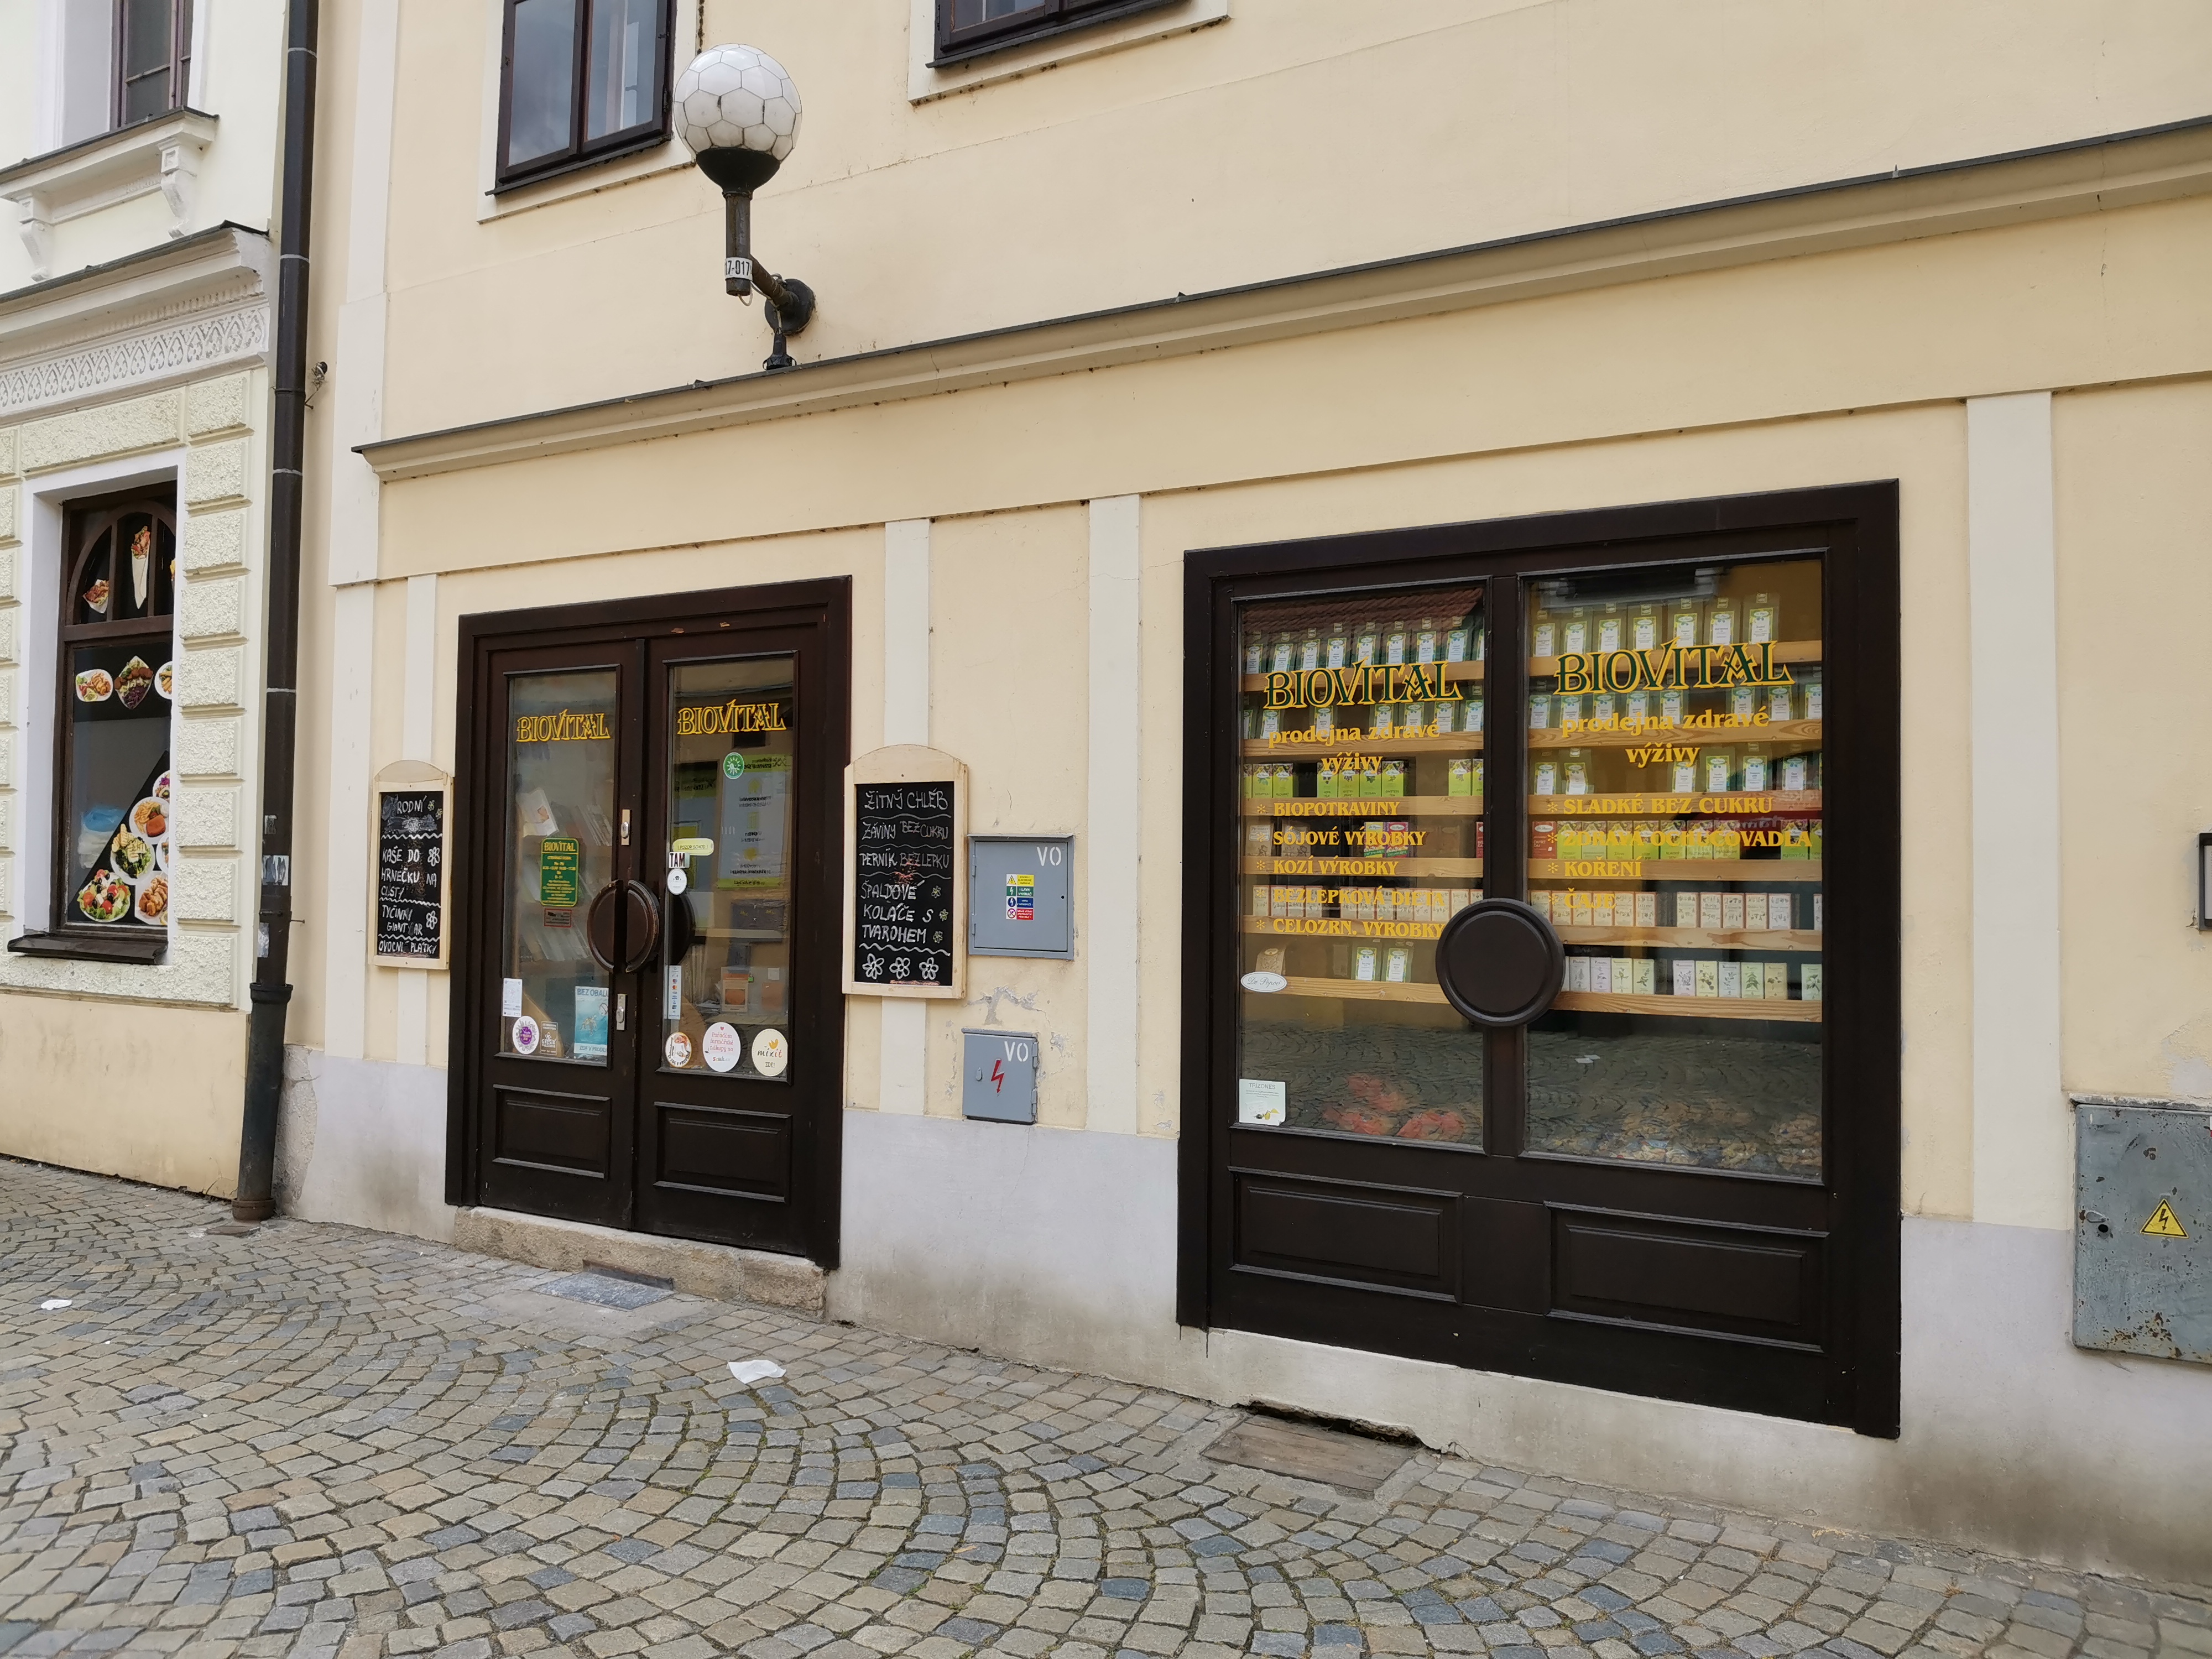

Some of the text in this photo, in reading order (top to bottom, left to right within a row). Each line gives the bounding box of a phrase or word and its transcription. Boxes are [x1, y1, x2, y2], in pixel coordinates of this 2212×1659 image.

[1553, 637, 1796, 695] BIOVITAL
[1264, 656, 1463, 709] BIOVITAL
[517, 709, 611, 742] BIOVITAL
[677, 699, 786, 734] BIOVITAL
[1562, 706, 1770, 738] prodejna zdravé
[1269, 719, 1440, 748] prodejna zdravé
[1321, 752, 1383, 774] výživy
[1625, 742, 1700, 768] výživy
[864, 787, 948, 810] ŽITNÝ CHLÉB
[1274, 801, 1400, 817] BIOPOTRAVINY
[1563, 793, 1773, 814] SLADKÉ BEZ CUKRU
[862, 821, 948, 840] ZÁVINY BEZ CUKRU
[1273, 826, 1426, 846] SÓJOVÉ VÝROBKY
[1563, 825, 1812, 847] ZDRAVÁ OCHUCOVADLA
[382, 846, 420, 864] KAŠE DO
[544, 841, 576, 851] BIOVITAL
[1036, 847, 1061, 866] VO
[670, 853, 685, 867] TAM
[859, 848, 898, 868] PERNÍK
[1274, 855, 1399, 875] KOZÍ VÝROBKY
[1564, 856, 1642, 877] KOŘENÍ
[382, 867, 437, 888] HRNEČKU NA
[860, 880, 925, 900] ŠPALDOVÉ
[1274, 886, 1445, 907] BEZLEPKOVÁ DIETA
[1563, 888, 1617, 909] ČAJE
[863, 902, 933, 922] KOLÁČE S
[410, 922, 423, 936] AR
[862, 924, 927, 943] TVAROHEM
[1274, 917, 1445, 938] CELOZRN. VÝROBKY
[1247, 976, 1258, 984] Dr.
[1004, 1041, 1029, 1062] VO
